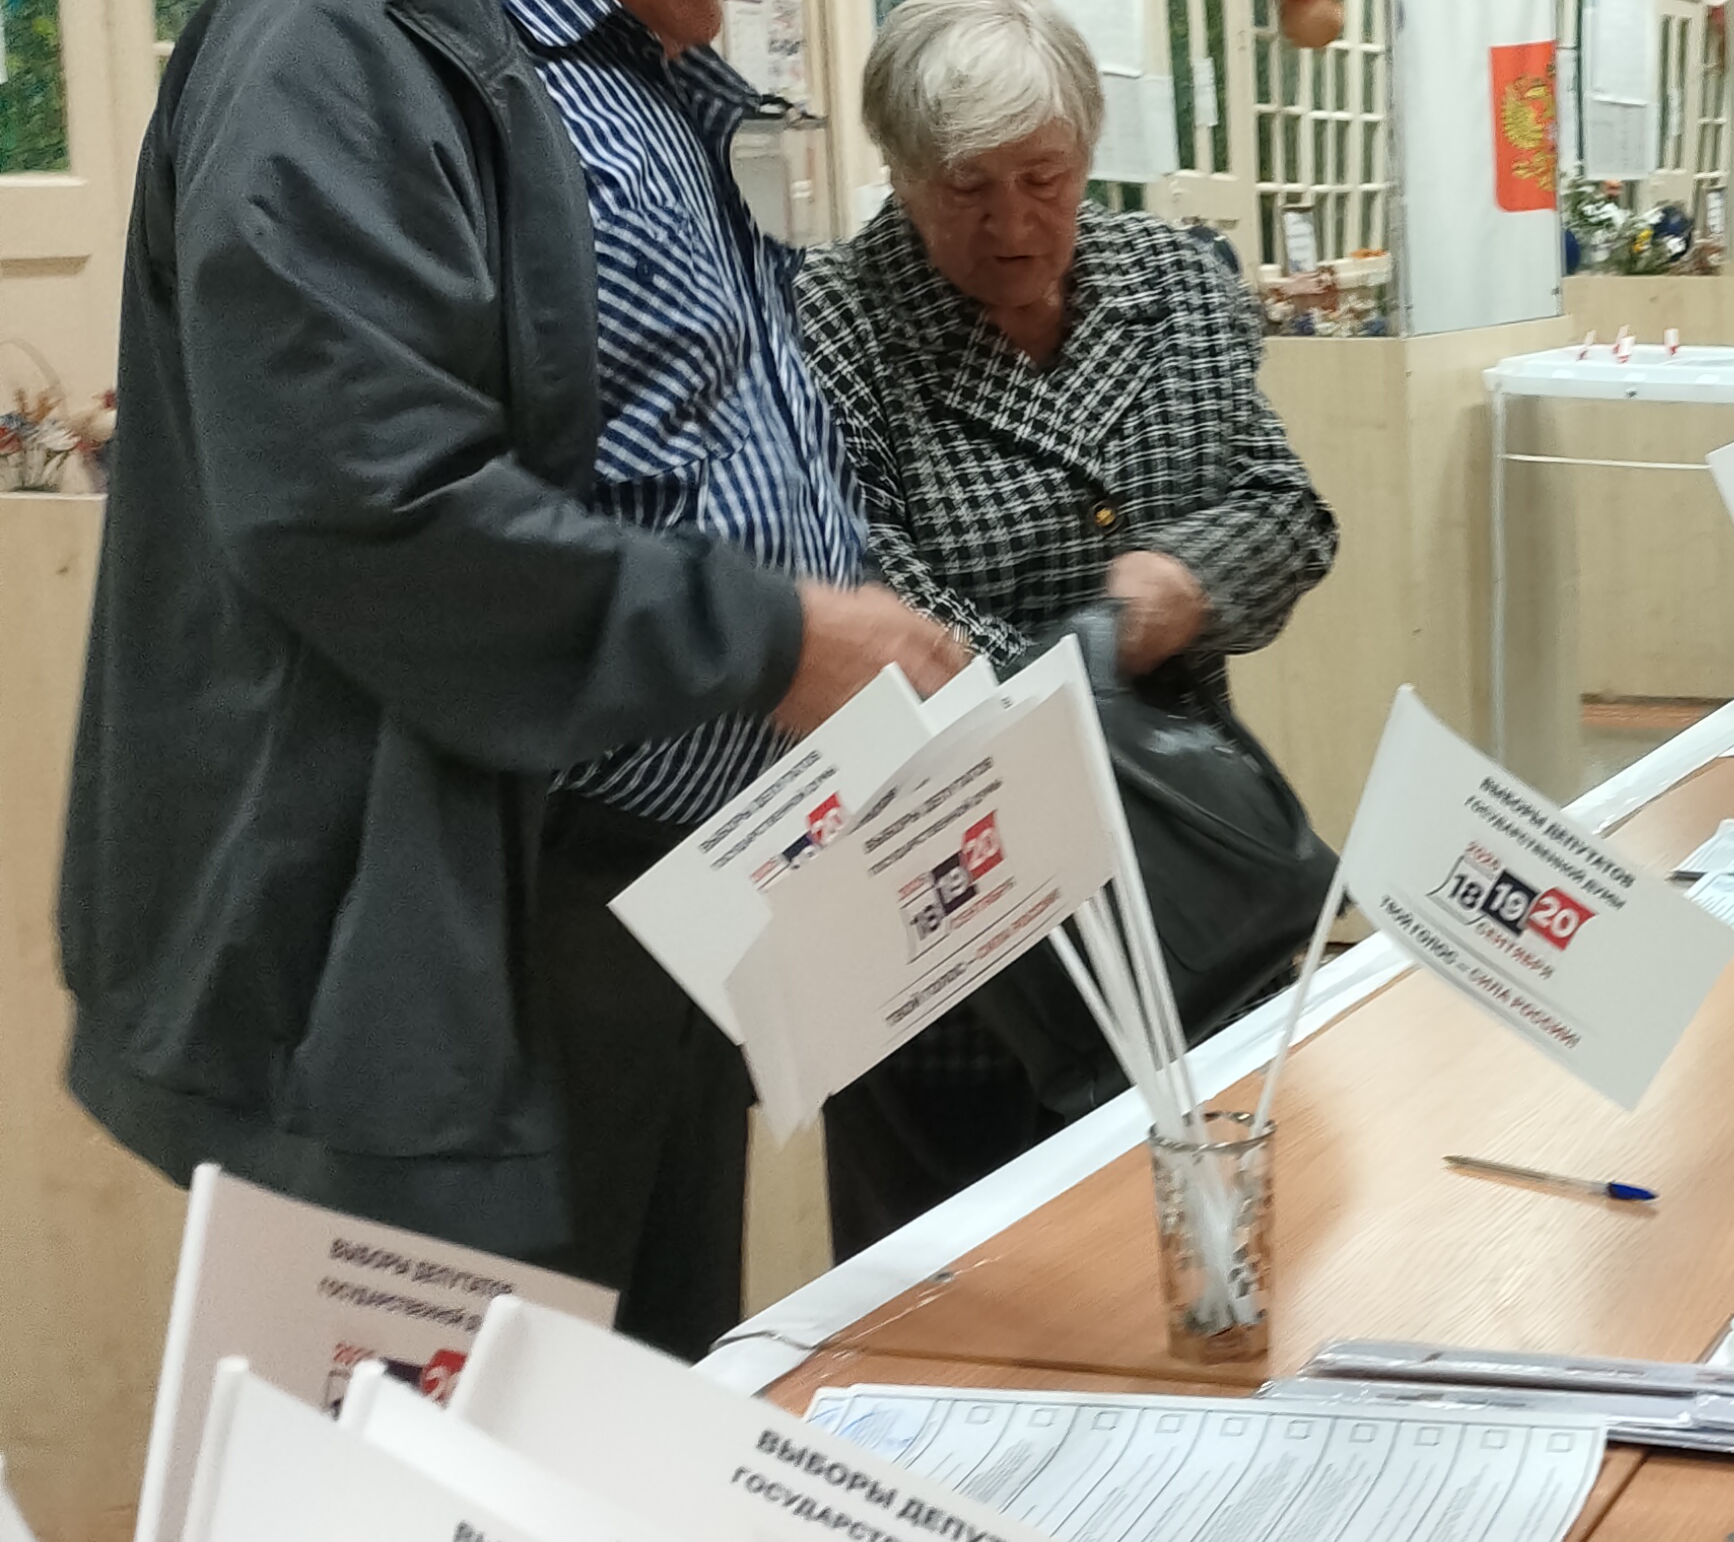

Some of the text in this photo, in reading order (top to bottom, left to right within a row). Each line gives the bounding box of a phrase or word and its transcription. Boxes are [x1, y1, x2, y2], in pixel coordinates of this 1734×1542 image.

[961, 828, 999, 870] 20
[1479, 776, 1548, 836] ВЫБОРЫ
[1545, 819, 1636, 889] ДЕПУТАТОВ
[1449, 872, 1580, 938] 18 19 20
[755, 1428, 897, 1511] ВЫБОРЫ
